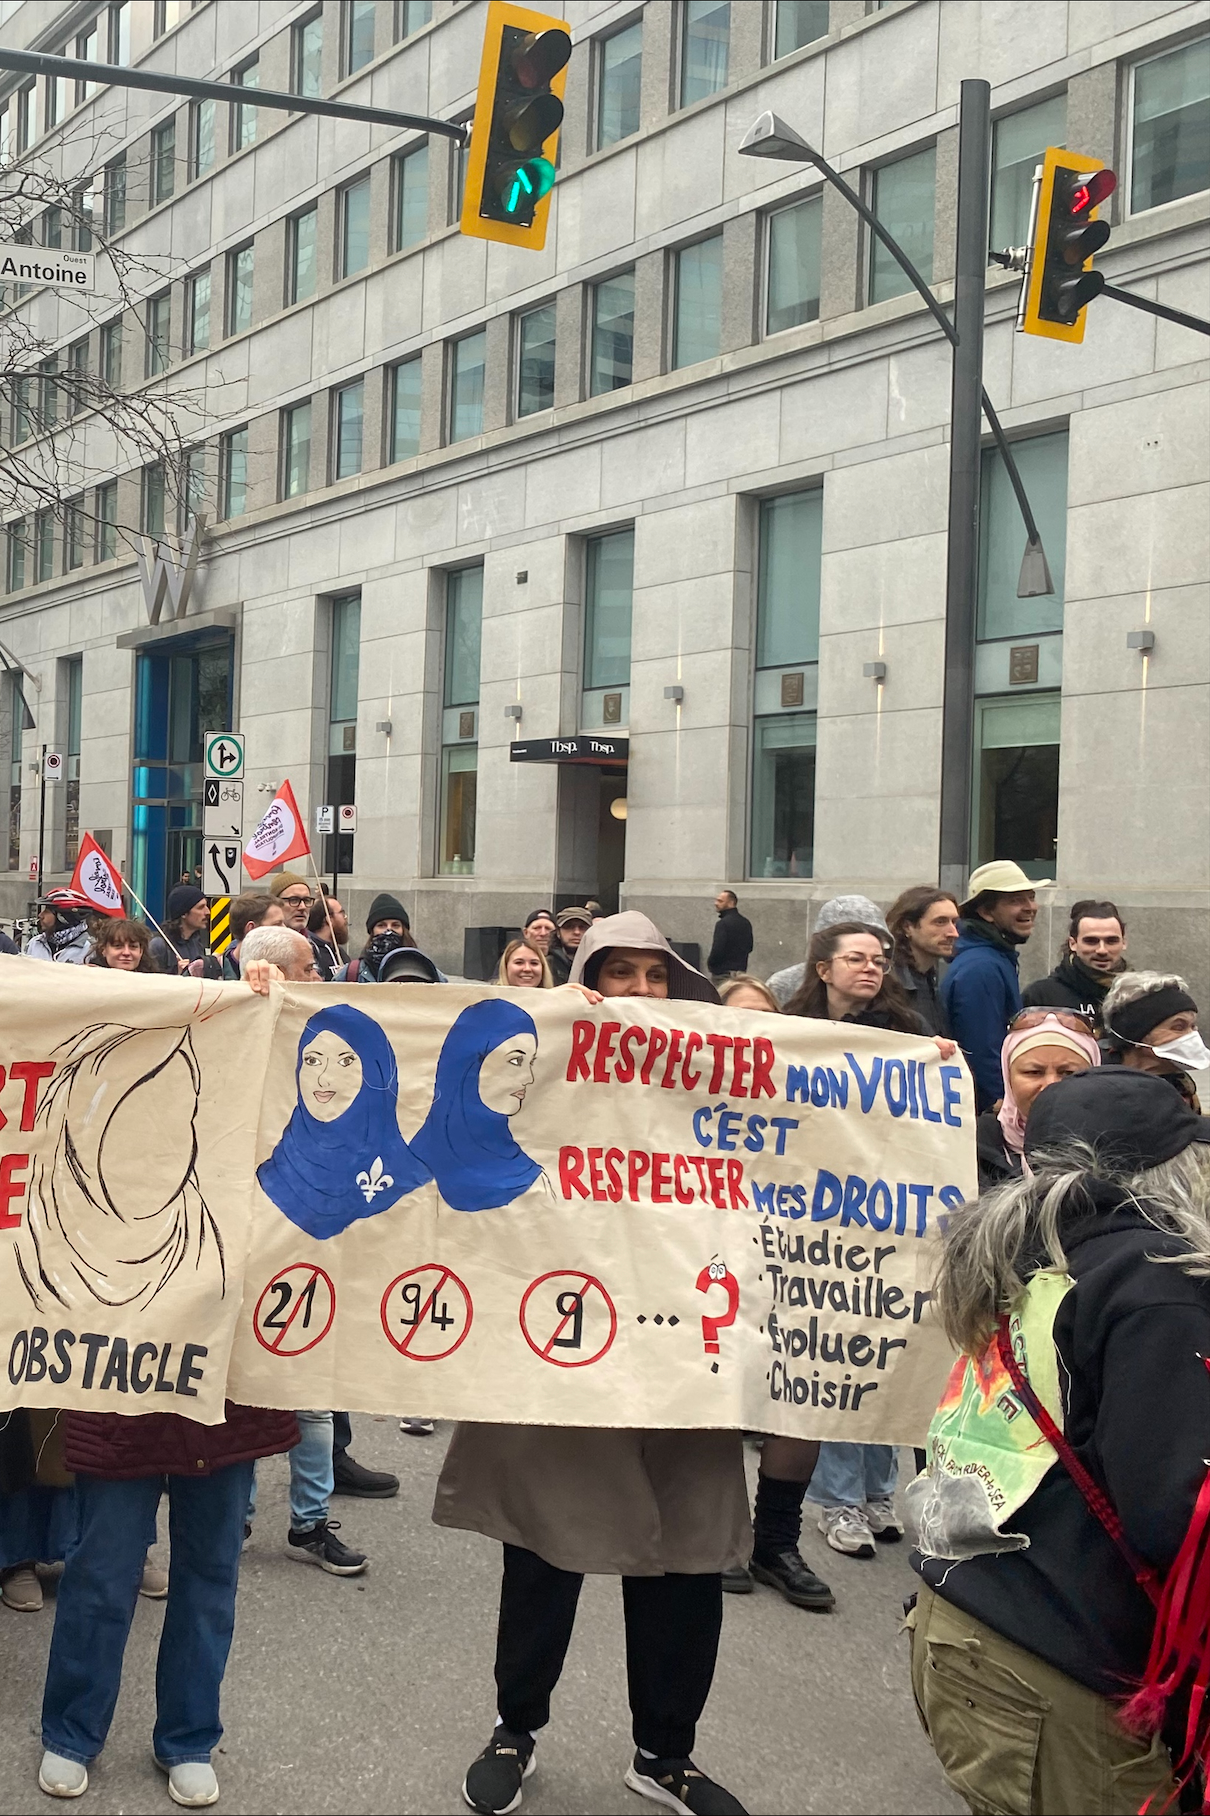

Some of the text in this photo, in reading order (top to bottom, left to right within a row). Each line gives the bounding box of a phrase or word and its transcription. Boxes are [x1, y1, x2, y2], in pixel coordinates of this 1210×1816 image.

[63, 254, 87, 265] Ouest
[550, 741, 577, 754] Tbsp.
[590, 741, 615, 754] Tbsp.
[566, 1019, 962, 1128] RESPECTER MON VOILE
[558, 1146, 749, 1210] RESPECTER
[751, 1178, 807, 1219] MES
[759, 1216, 896, 1274] Étudier
[263, 1278, 317, 1328] 21
[400, 1283, 454, 1331] 94
[553, 1291, 583, 1349] 9
[766, 1264, 937, 1324] Travailler
[8, 1326, 209, 1397] OBSTACLE
[768, 1304, 907, 1370] Évoluer
[771, 1360, 878, 1411] Choisir
[963, 1462, 991, 1481] RIVER
[988, 1488, 1006, 1512] SEA
